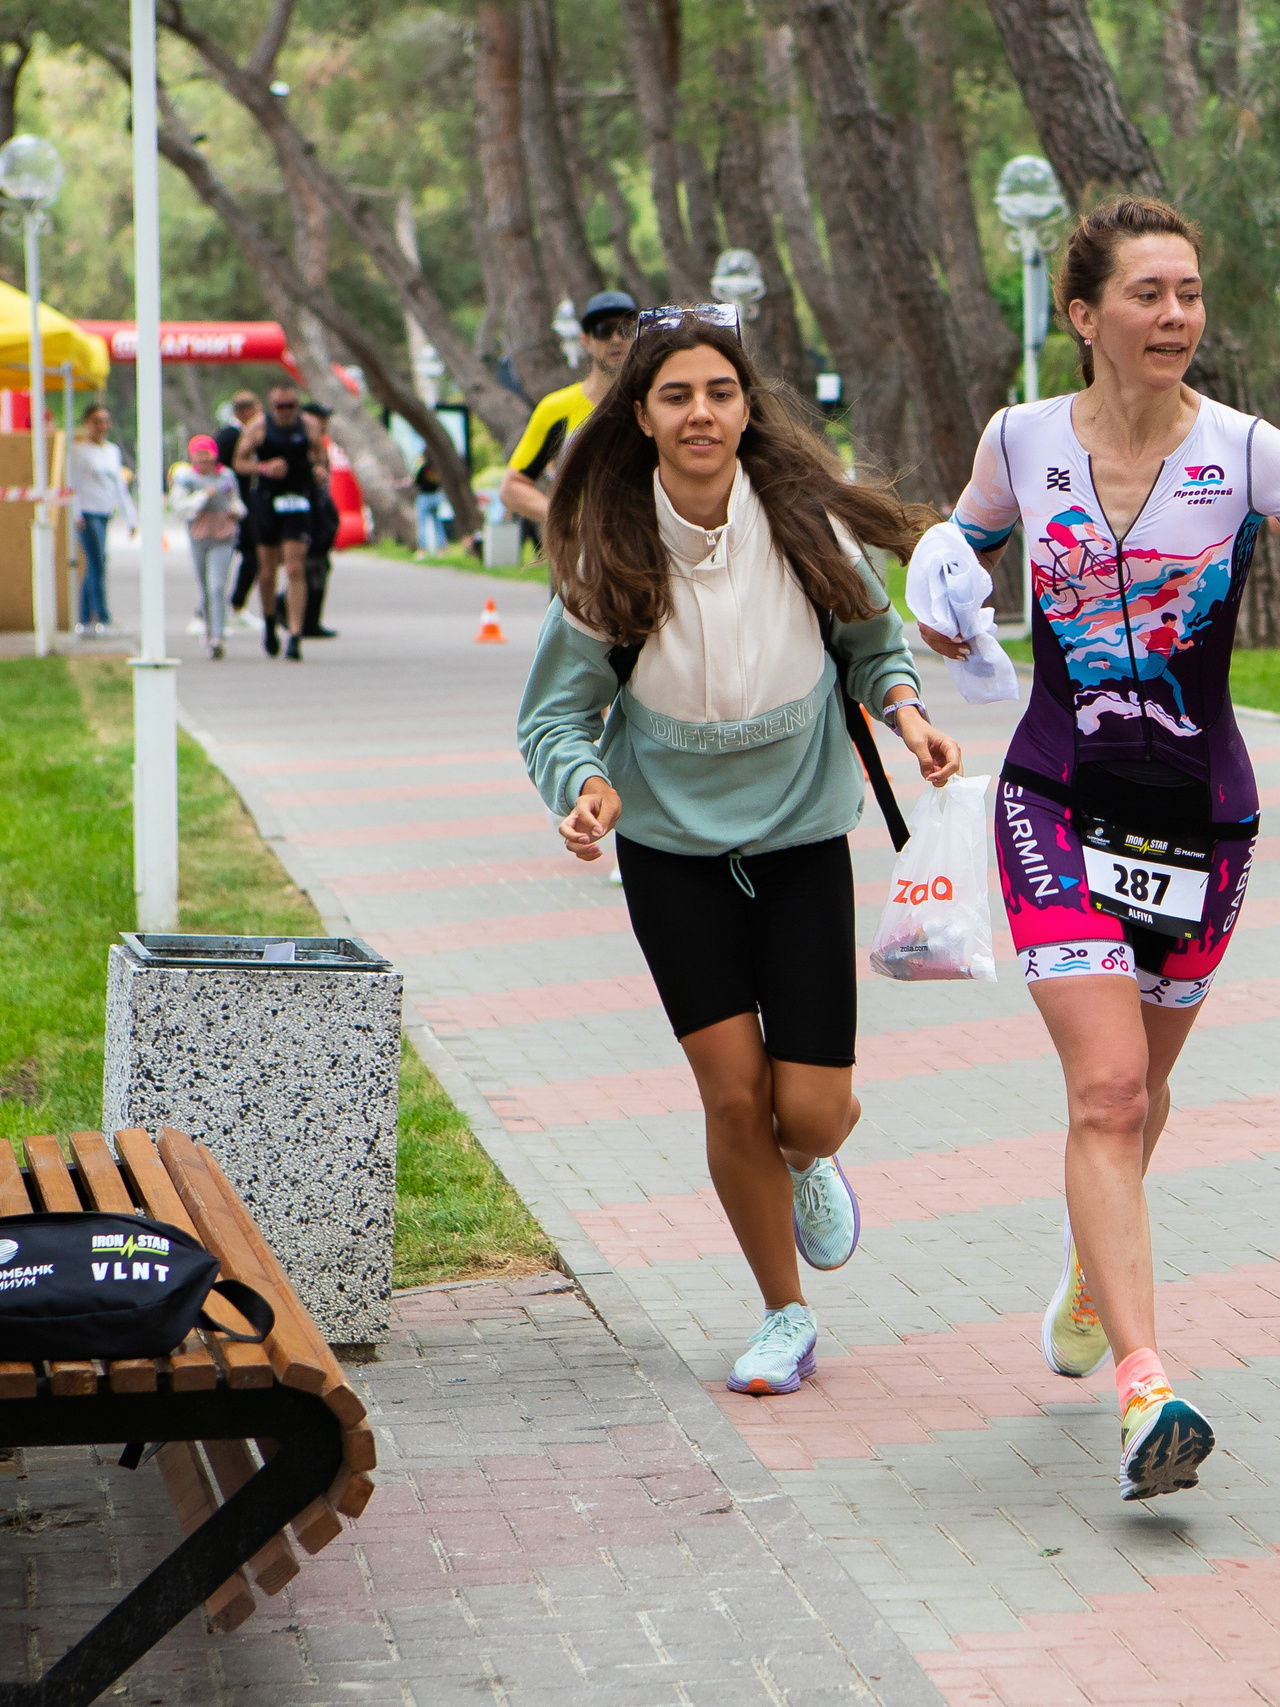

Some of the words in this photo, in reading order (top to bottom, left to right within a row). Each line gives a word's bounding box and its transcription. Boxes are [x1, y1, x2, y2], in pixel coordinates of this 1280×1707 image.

[158, 333, 247, 357] АГНИТ
[1173, 488, 1233, 498] Преодолей
[1187, 497, 1217, 505] себя!
[1003, 781, 1060, 898] GARMIN
[1125, 834, 1144, 847] IRON
[1150, 839, 1169, 851] STAR
[1112, 863, 1172, 906] 287
[1128, 907, 1154, 924] ALFIYA
[92, 1234, 124, 1248] IRON
[137, 1234, 170, 1251] STAR
